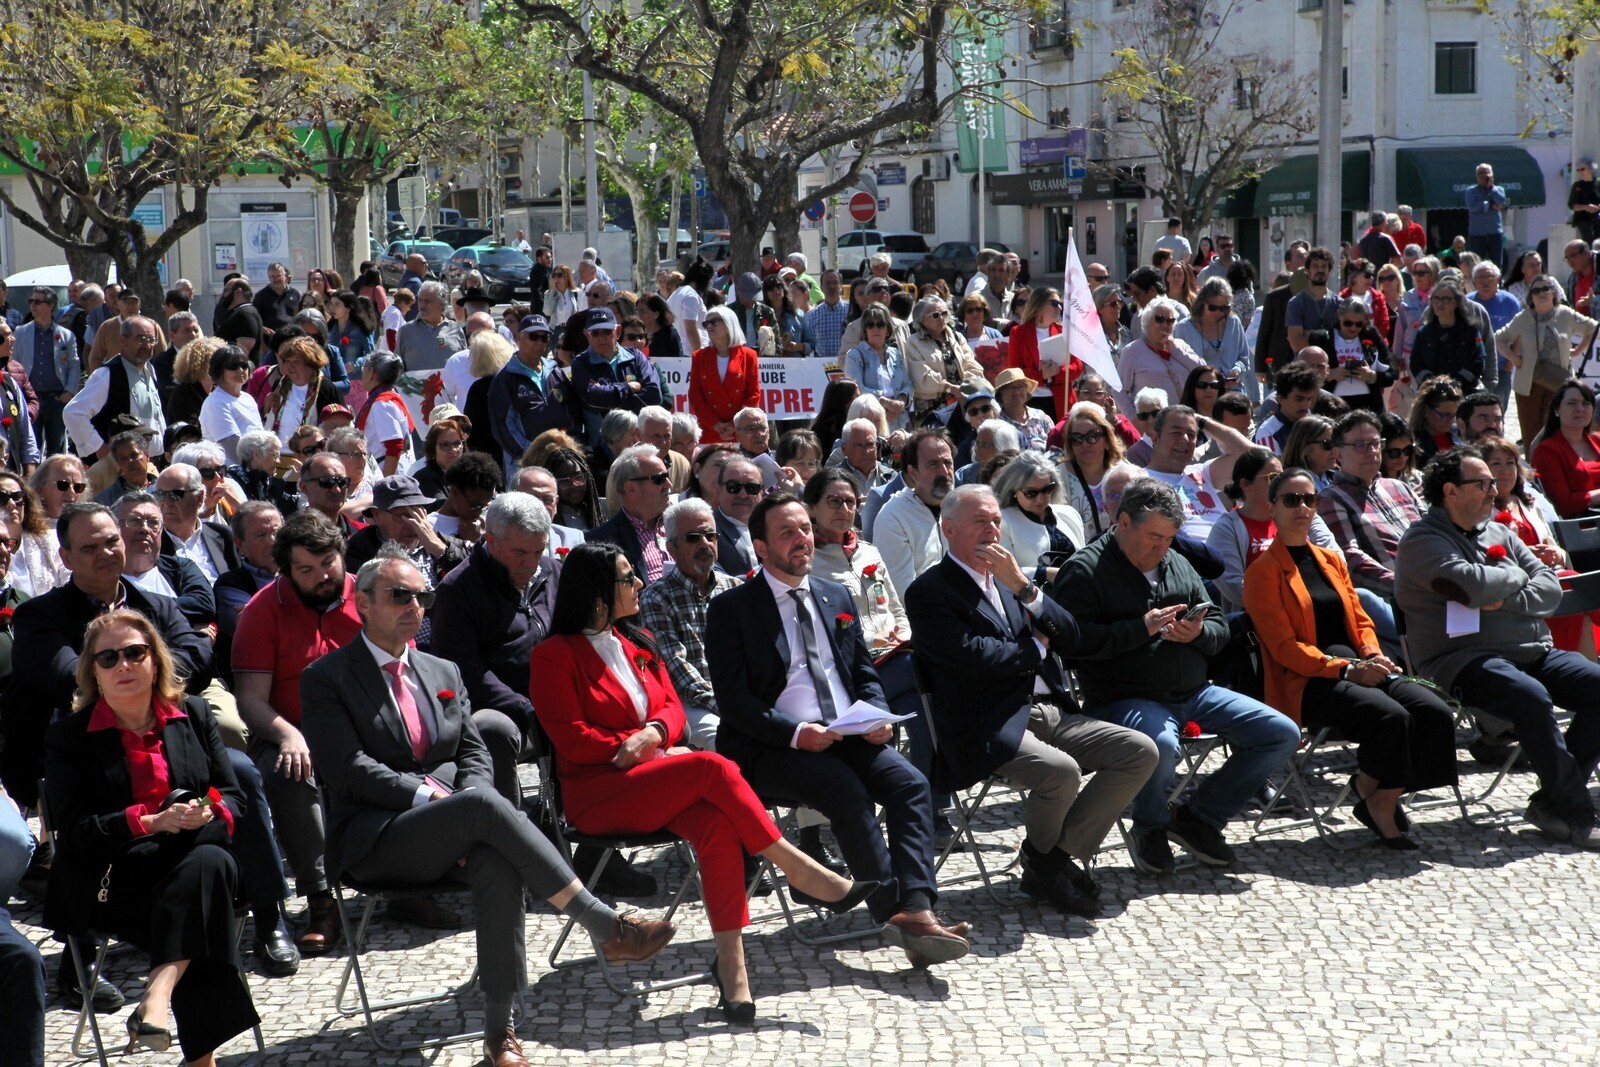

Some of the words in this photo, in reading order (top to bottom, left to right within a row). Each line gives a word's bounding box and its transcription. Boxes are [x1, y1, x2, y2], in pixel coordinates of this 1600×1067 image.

[1028, 179, 1046, 192] VERA
[1047, 178, 1068, 190] AMAR
[664, 371, 681, 384] IO
[759, 371, 786, 384] UBE
